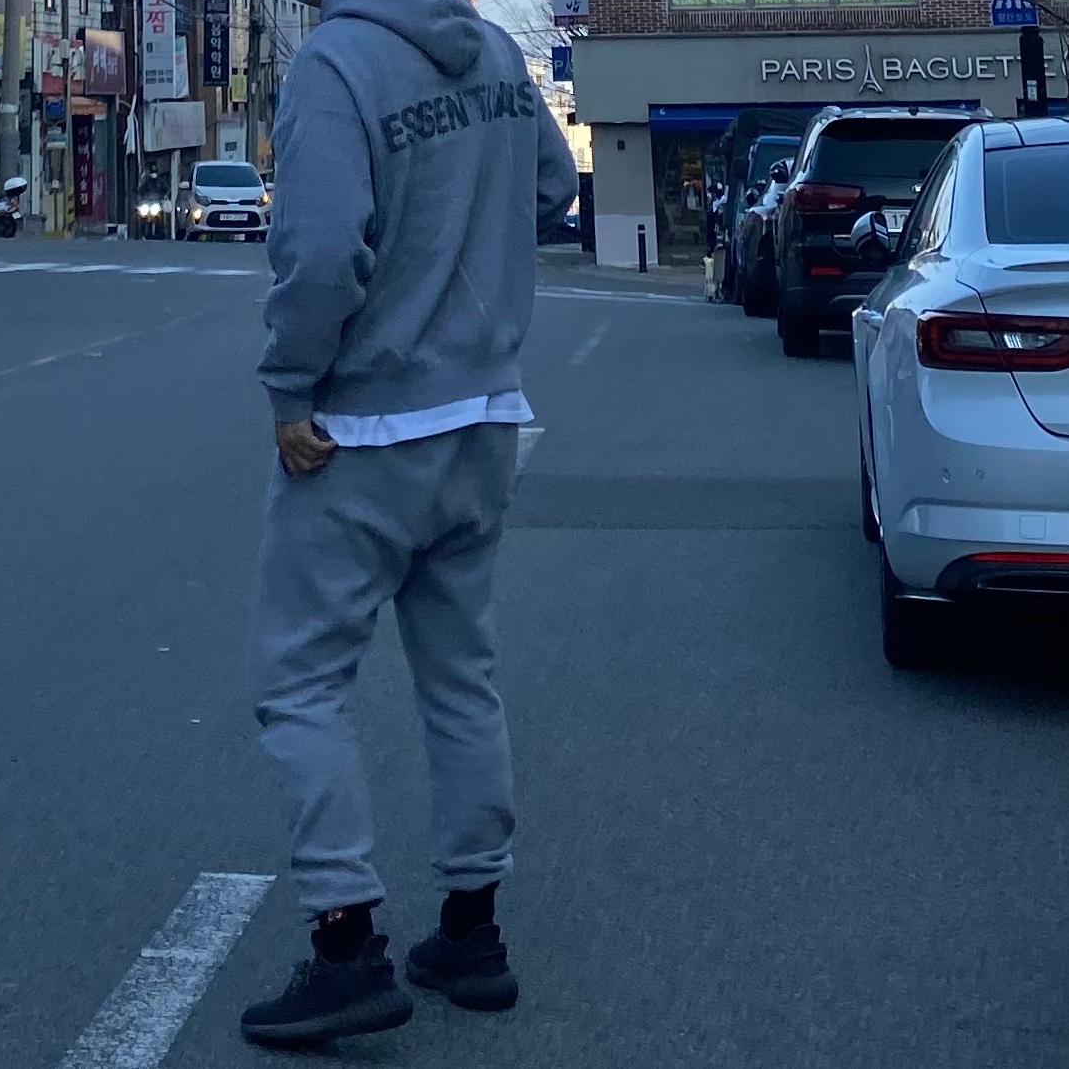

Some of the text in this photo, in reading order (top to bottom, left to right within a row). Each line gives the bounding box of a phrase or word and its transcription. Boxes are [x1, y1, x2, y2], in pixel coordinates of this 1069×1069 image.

[761, 55, 1057, 81] PARIS BAGUETE
[379, 81, 534, 153] ESSENTIAS
